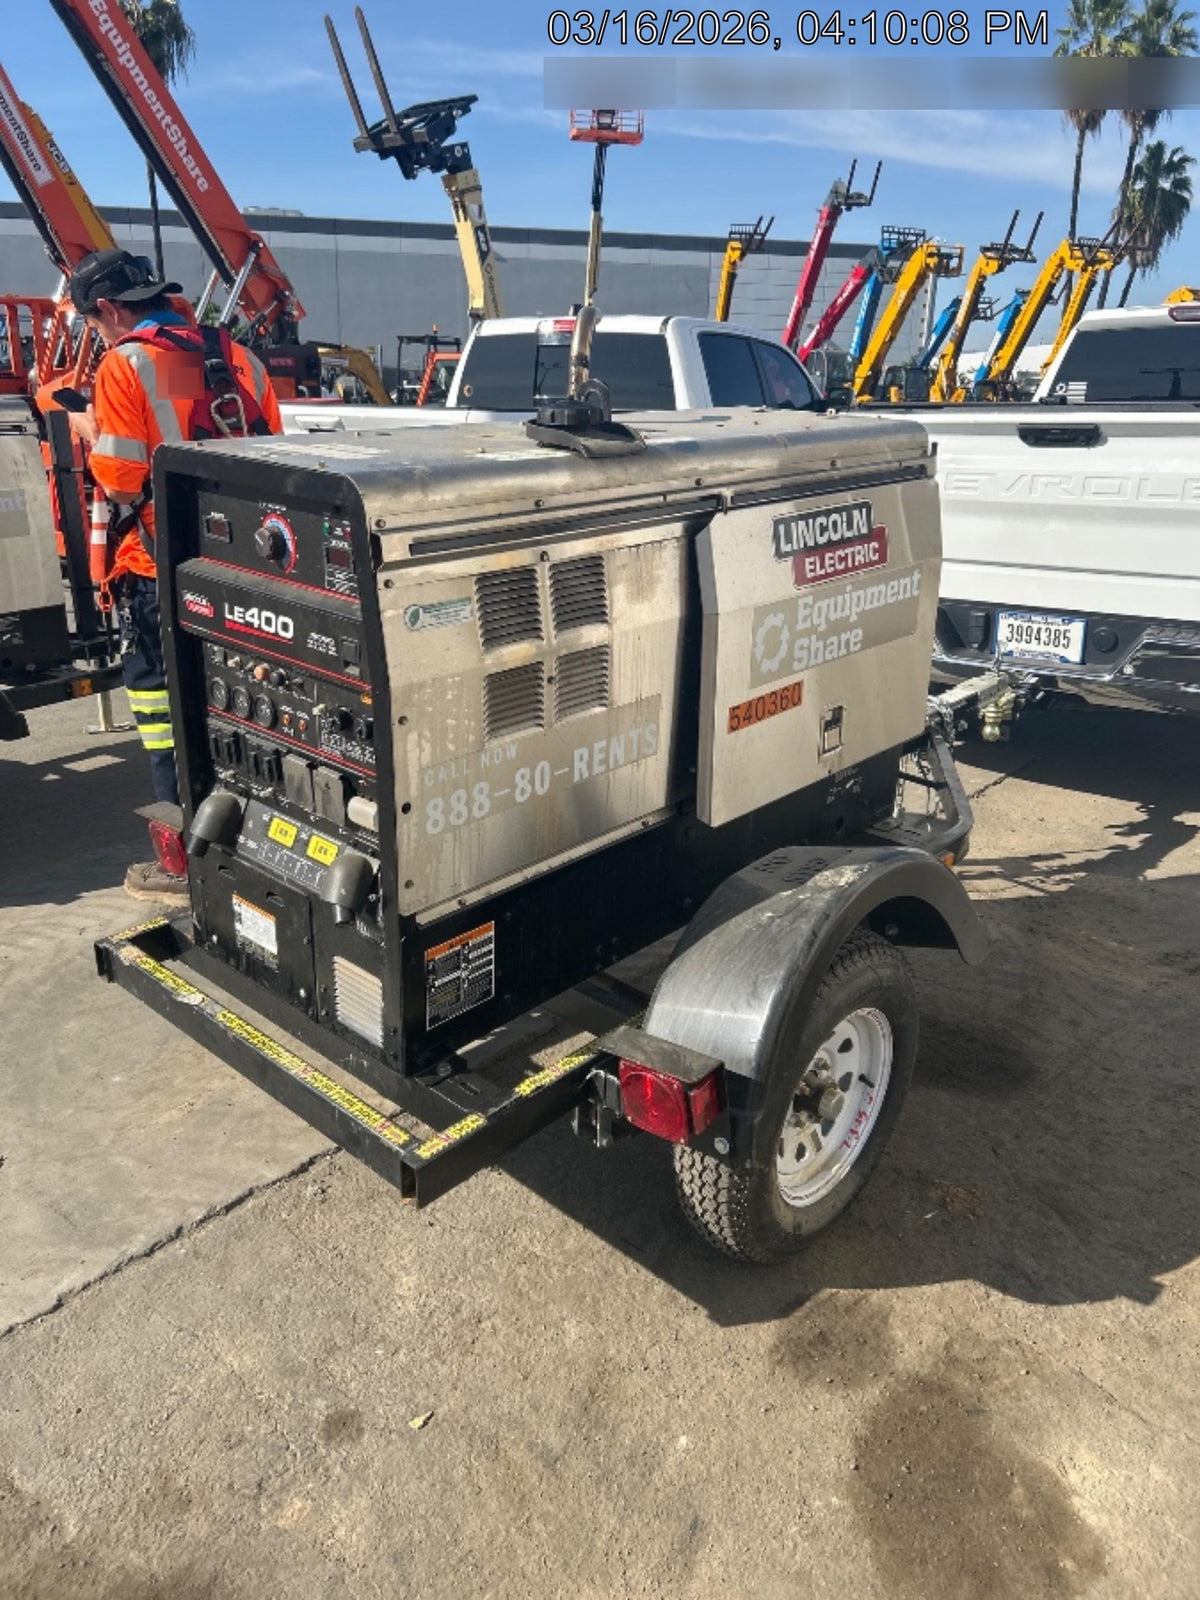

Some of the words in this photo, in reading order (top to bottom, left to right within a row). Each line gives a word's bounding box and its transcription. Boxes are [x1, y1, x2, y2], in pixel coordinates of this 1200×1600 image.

[88, 0, 209, 192] EquipmentShare
[778, 507, 869, 554] LINCOLN
[804, 541, 880, 579] ELECTRIC
[224, 602, 295, 640] LE400
[795, 567, 922, 632] Equipment
[792, 626, 864, 671] Share
[1006, 623, 1071, 650] 3994385
[729, 682, 803, 732] 540360
[424, 758, 471, 787] CALL
[480, 742, 518, 769] NOW
[425, 722, 657, 835] 888-80-RENTS
